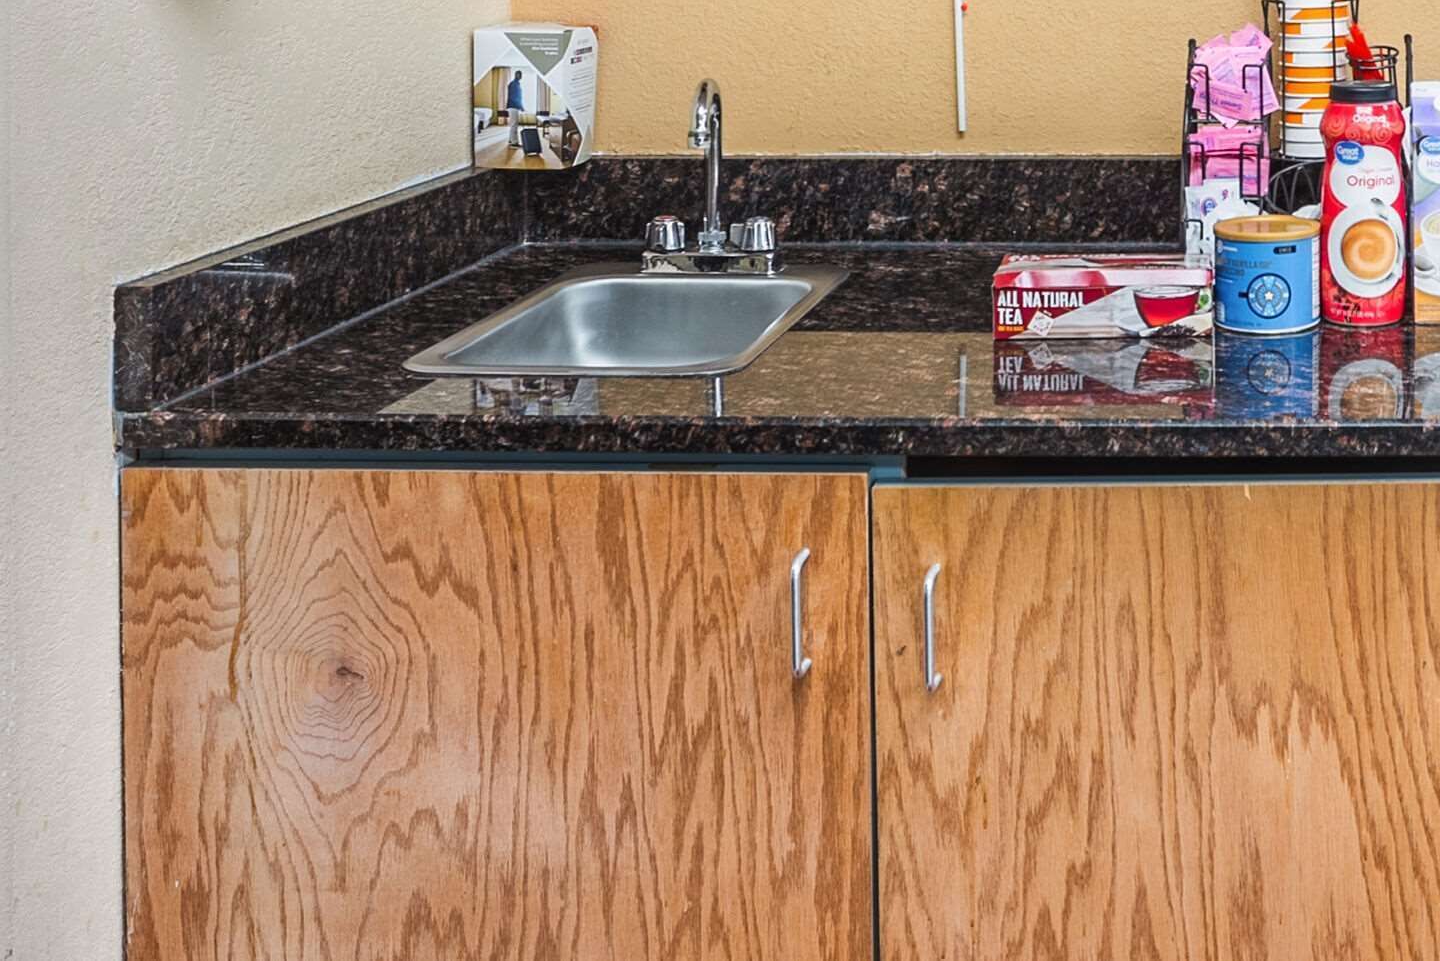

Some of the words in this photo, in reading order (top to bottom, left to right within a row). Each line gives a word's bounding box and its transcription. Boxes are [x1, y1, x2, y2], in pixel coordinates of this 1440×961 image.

[1346, 174, 1395, 190] Original
[997, 290, 1019, 307] ALL
[1023, 291, 1084, 308] NATURAL
[997, 308, 1023, 325] TEA
